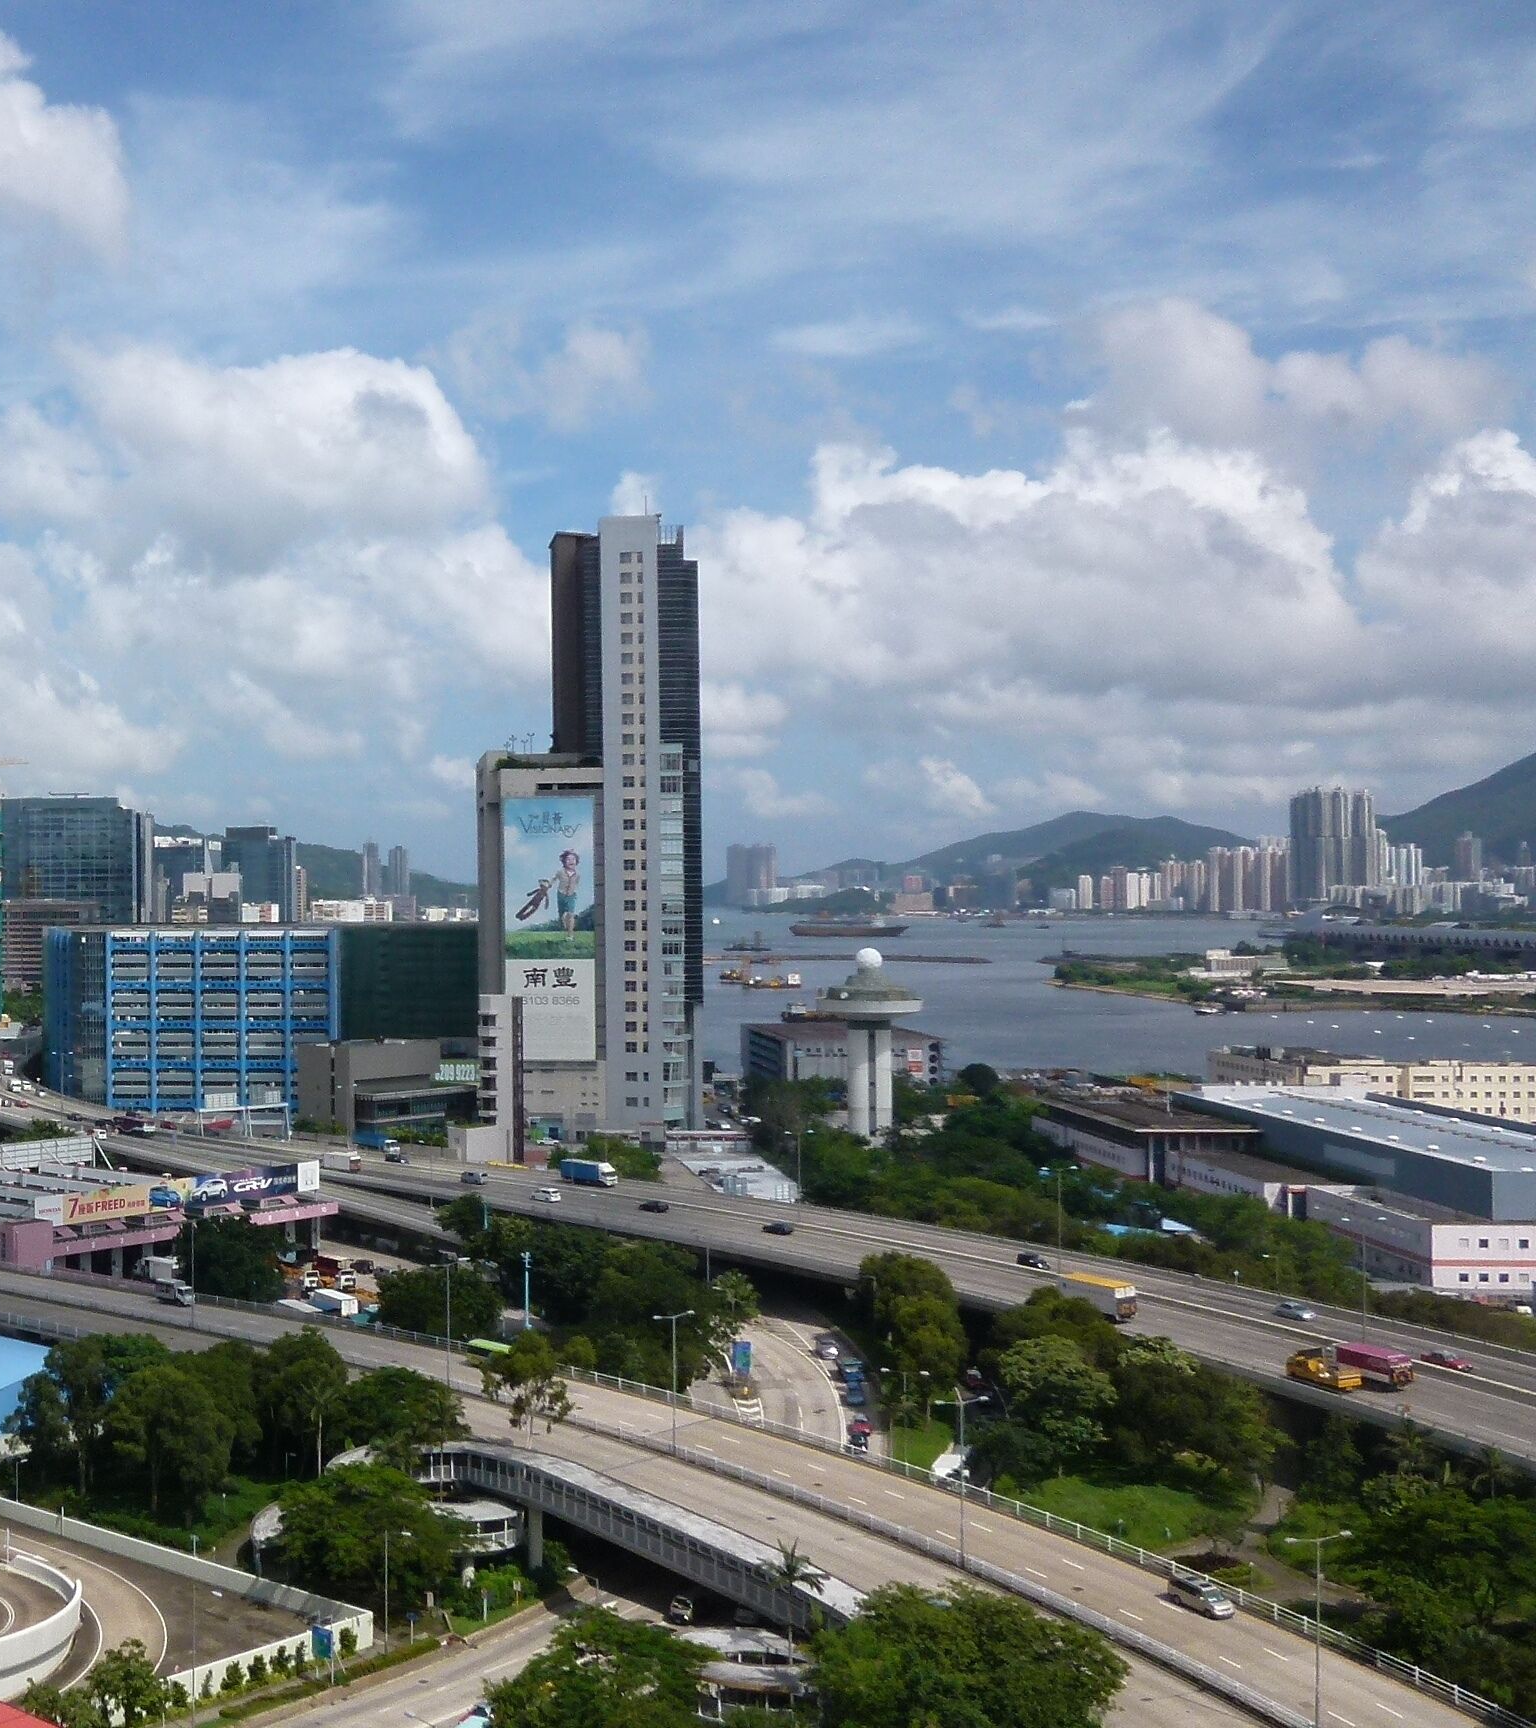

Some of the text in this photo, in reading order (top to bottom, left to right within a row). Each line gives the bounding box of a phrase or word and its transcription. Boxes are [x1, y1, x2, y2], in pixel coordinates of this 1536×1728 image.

[523, 967, 577, 988] 南豐
[552, 996, 580, 1005] 8366
[95, 1198, 126, 1213] FREED
